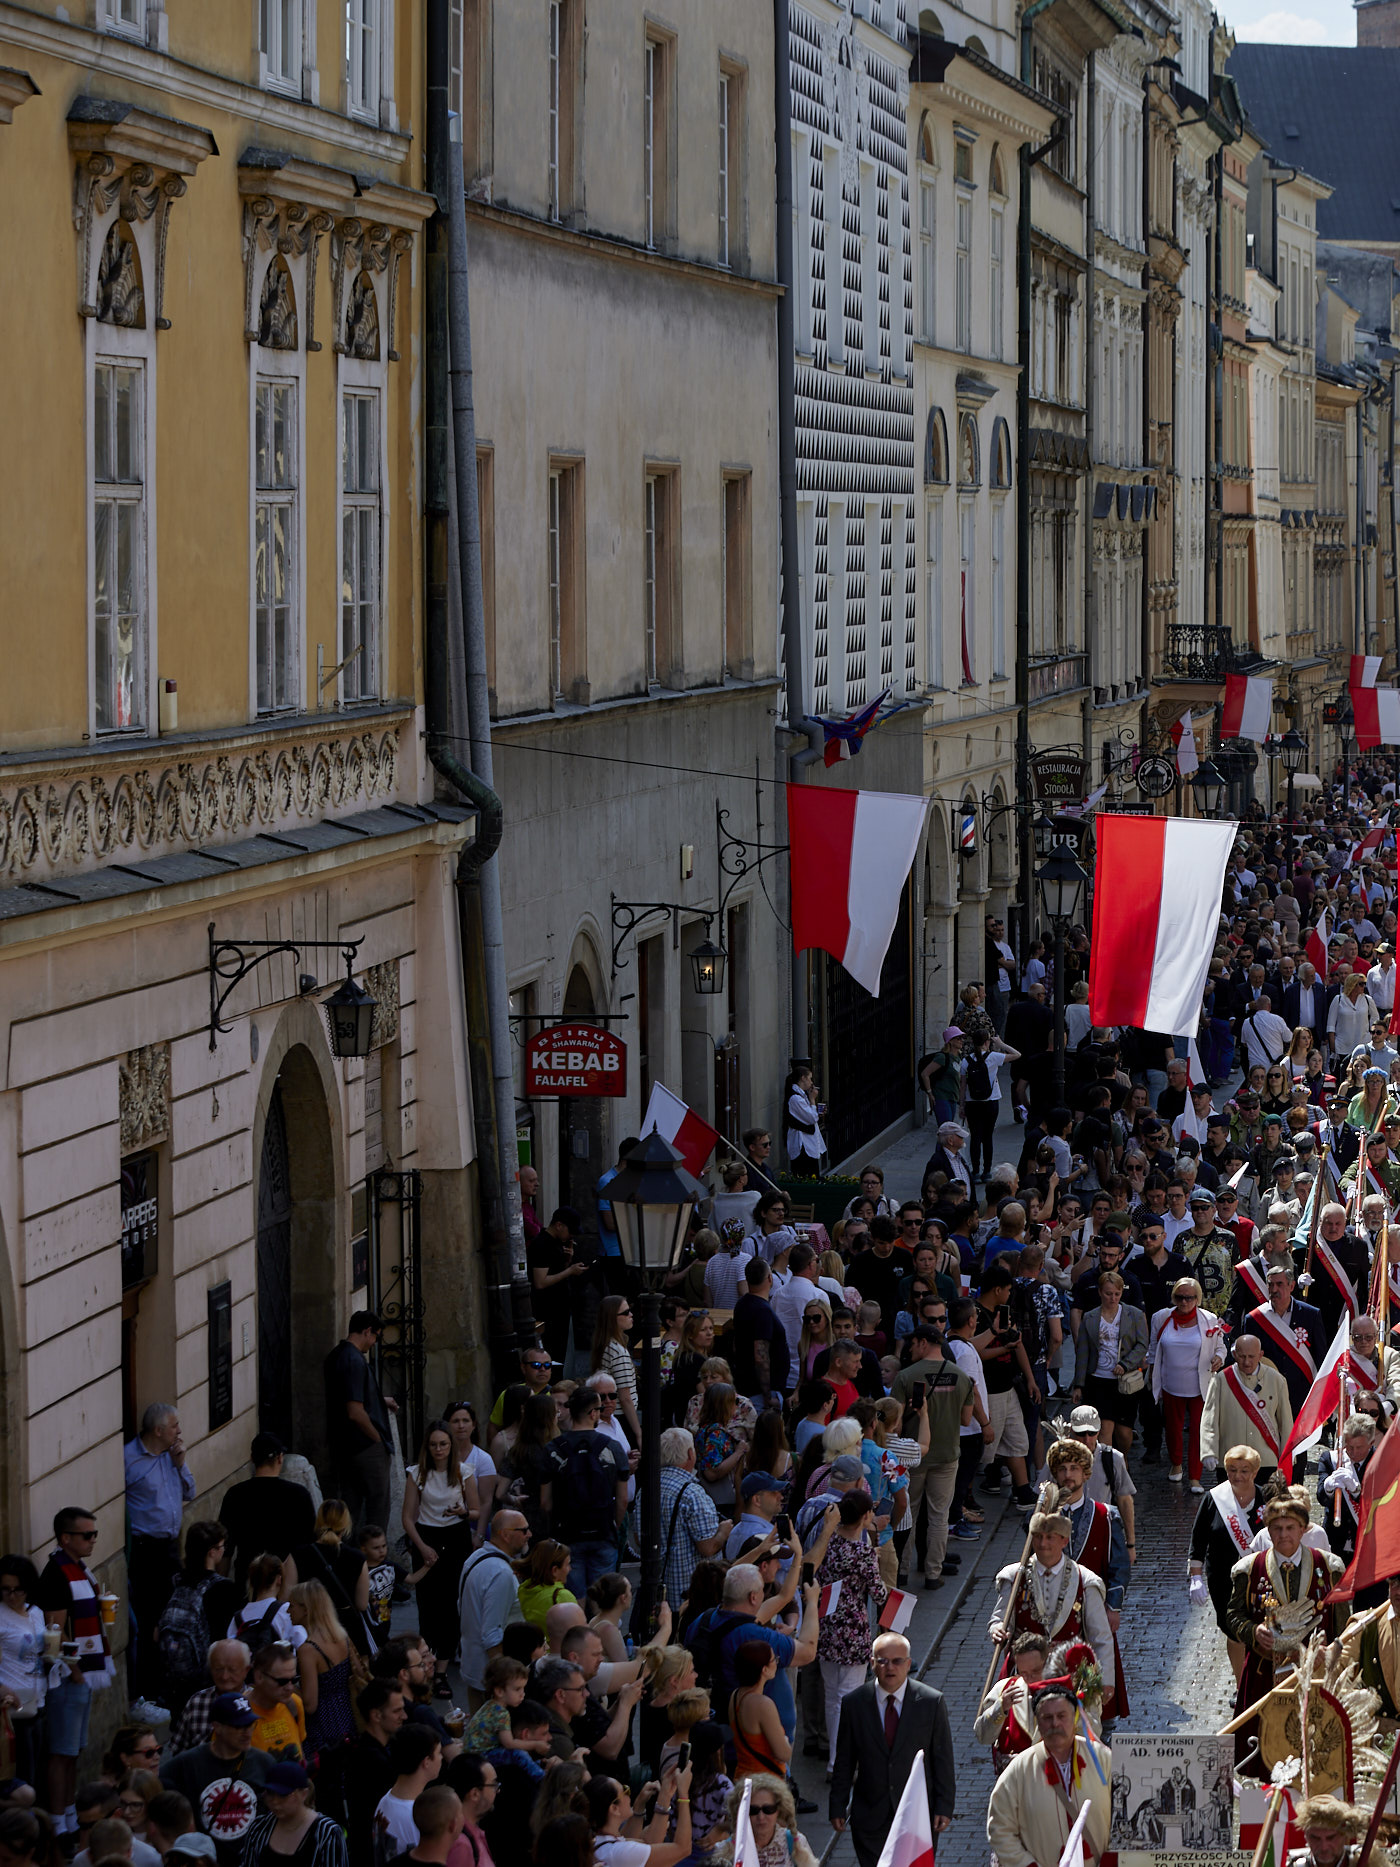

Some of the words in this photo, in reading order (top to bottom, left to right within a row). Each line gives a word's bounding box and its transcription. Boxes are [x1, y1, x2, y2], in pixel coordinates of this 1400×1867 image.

[1037, 763, 1081, 776] RESTAURACJA
[1044, 783, 1075, 796] STODOŁA
[700, 969, 711, 980] 51
[336, 1022, 355, 1039] 53
[538, 1029, 618, 1050] BEIRUT
[552, 1039, 600, 1050] SHAWARMA
[532, 1051, 620, 1072] KEBAB
[535, 1074, 588, 1087] FALAFEL
[1115, 1737, 1158, 1746] CHRZEST
[1161, 1737, 1194, 1746] POLSKI
[1130, 1747, 1150, 1758] AD.
[1157, 1747, 1184, 1758] 966
